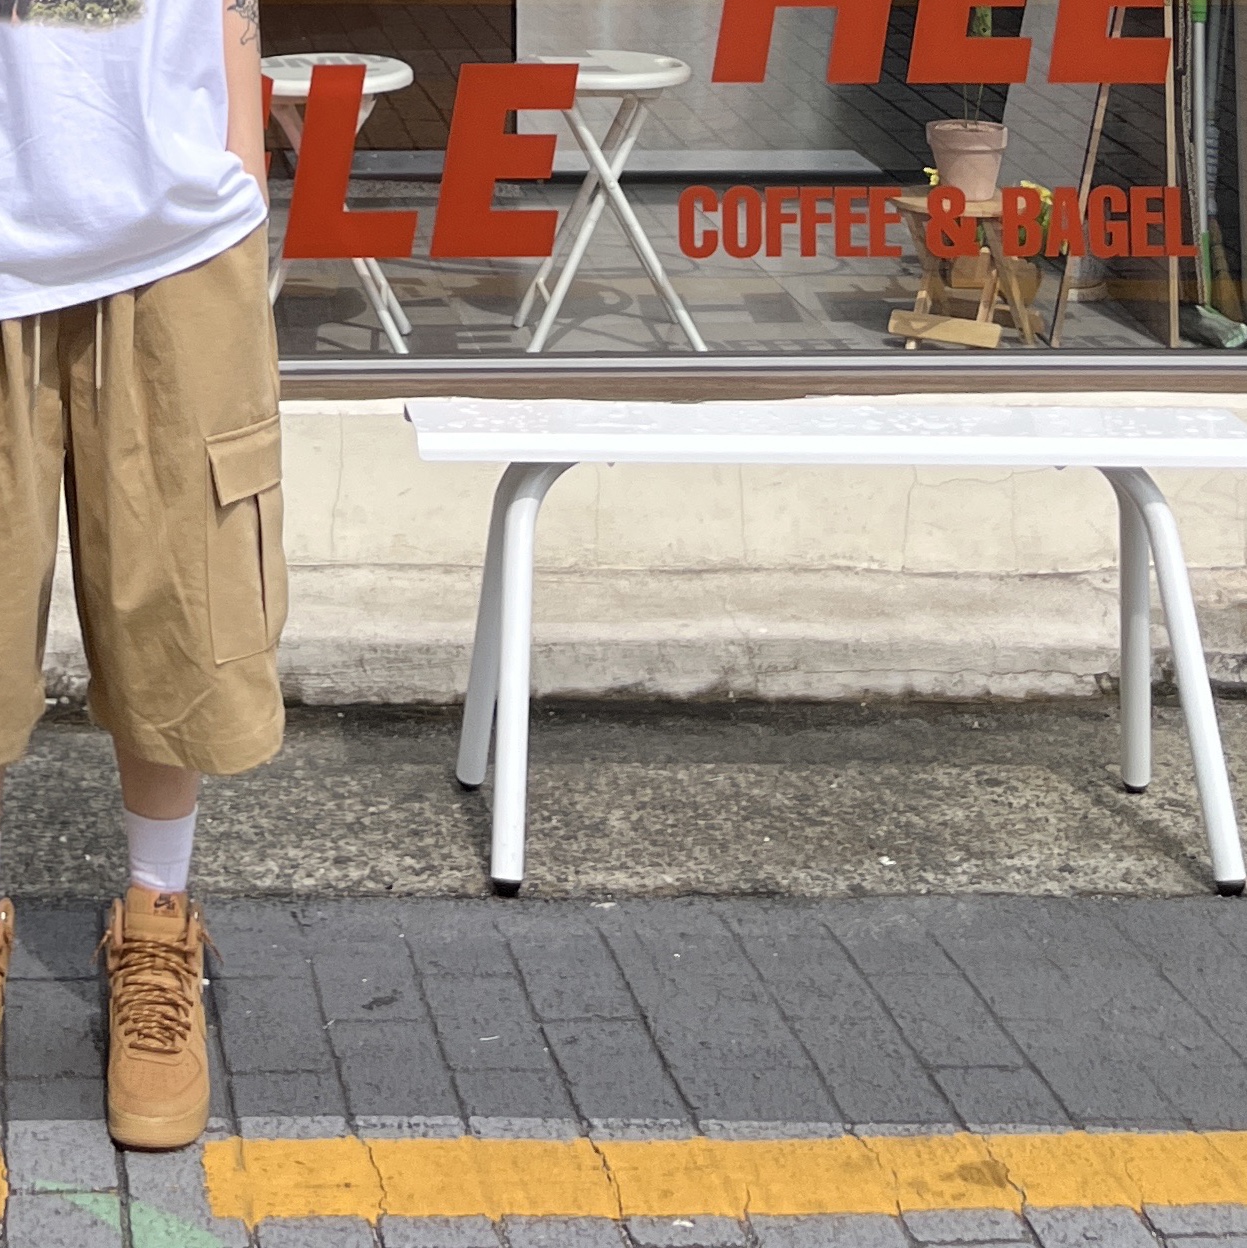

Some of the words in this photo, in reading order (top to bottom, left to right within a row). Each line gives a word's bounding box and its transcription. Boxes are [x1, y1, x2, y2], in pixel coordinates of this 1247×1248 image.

[262, 63, 579, 260] LE
[678, 185, 903, 260] COFFEE
[922, 183, 981, 261] &
[1002, 185, 1200, 260] BAGEL
